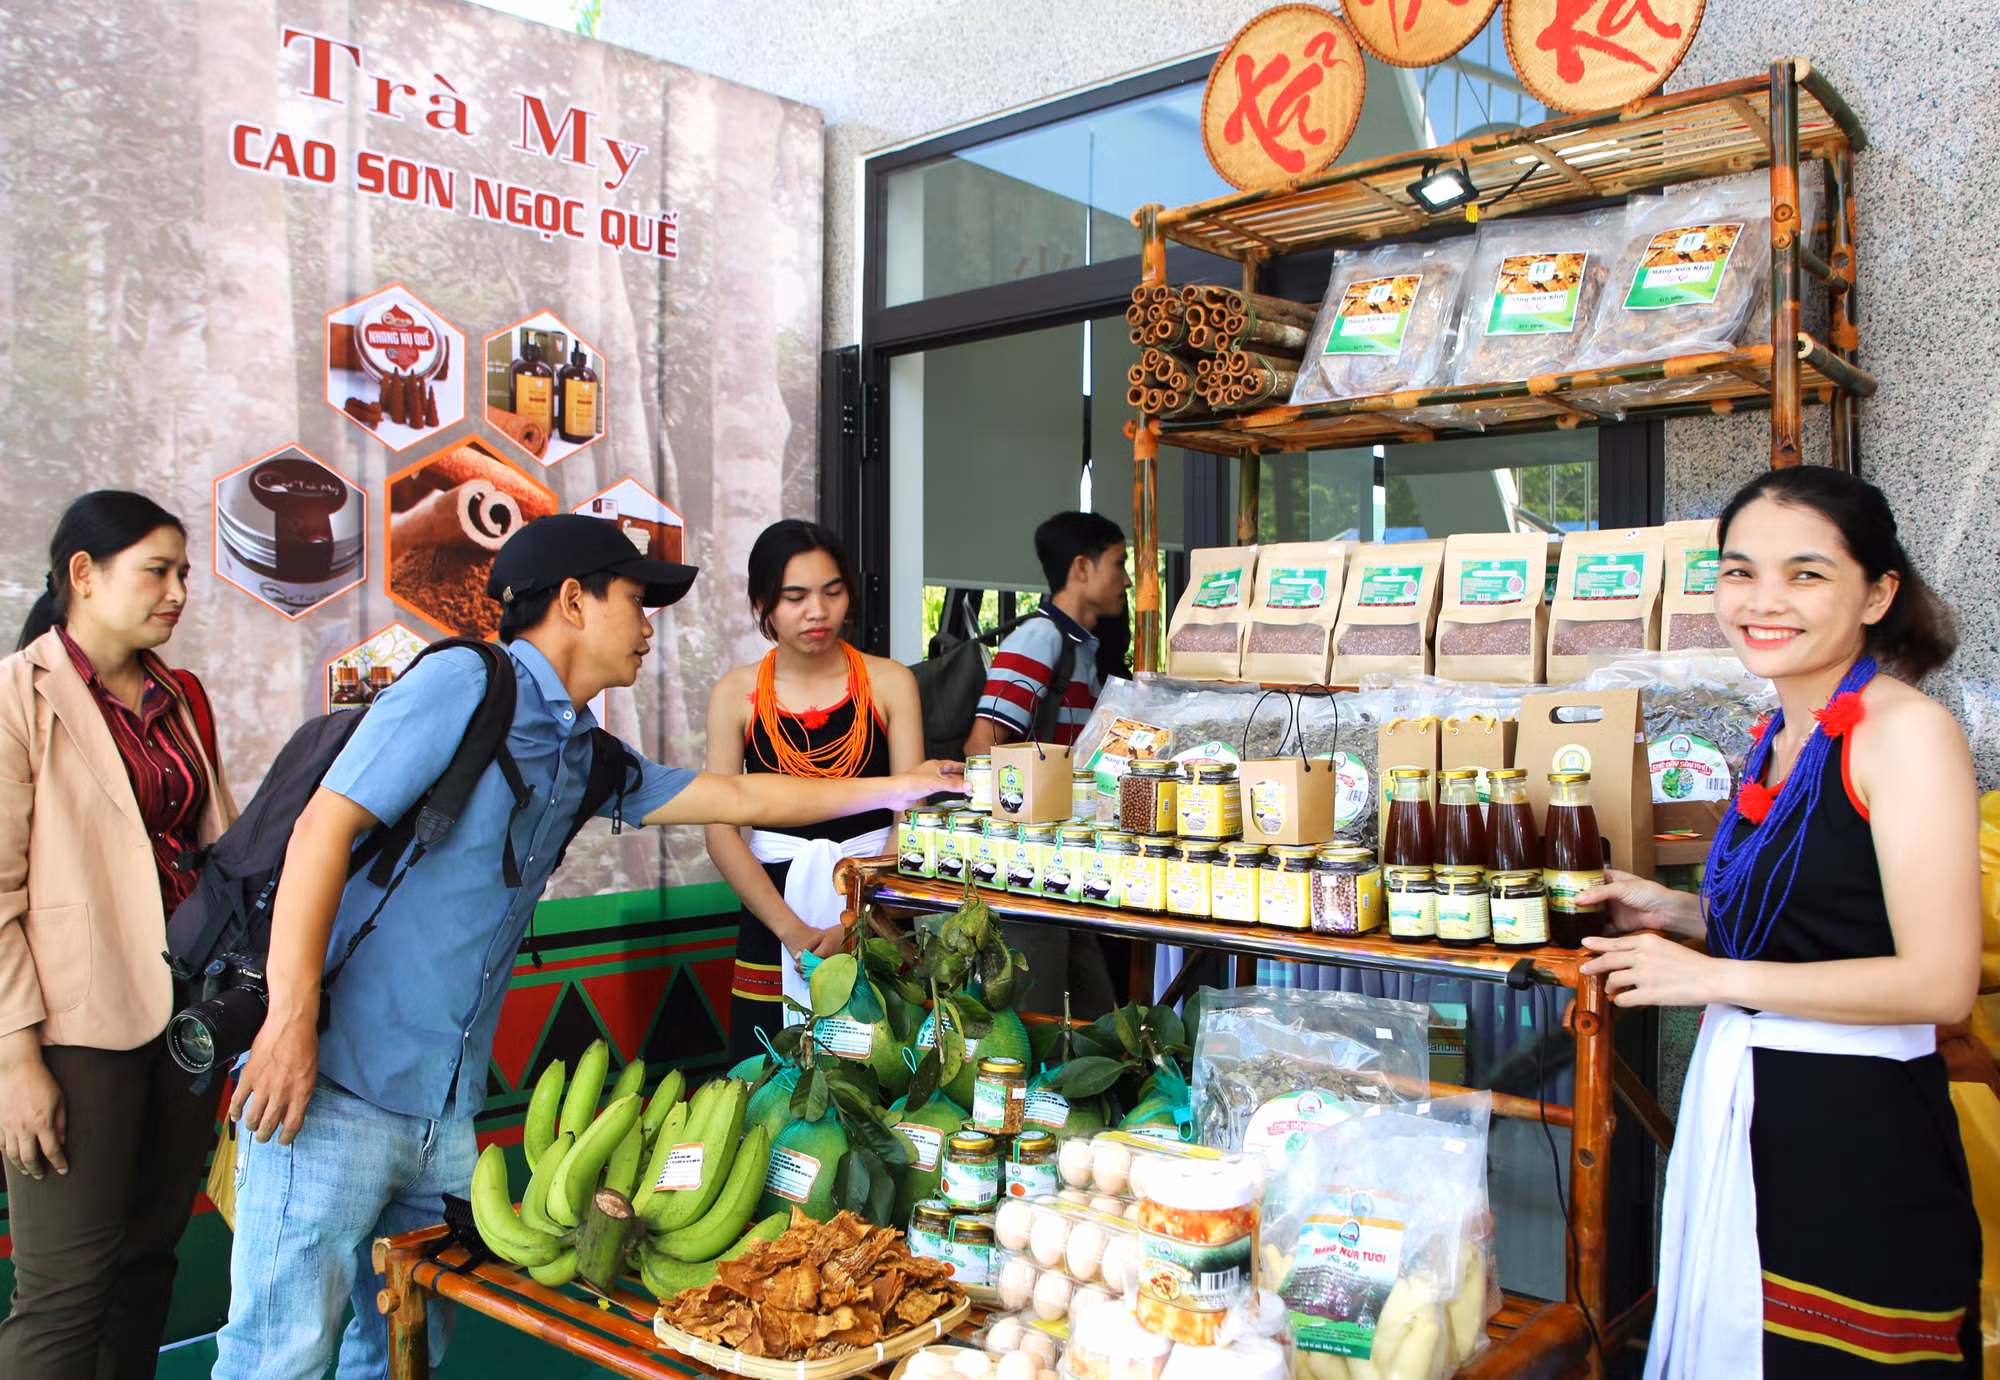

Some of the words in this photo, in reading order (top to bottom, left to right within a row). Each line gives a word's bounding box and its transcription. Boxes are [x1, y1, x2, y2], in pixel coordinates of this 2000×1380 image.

[282, 28, 476, 137] Trà
[511, 90, 647, 191] My
[232, 124, 336, 184] CAO
[357, 151, 455, 210] SƠN
[474, 178, 586, 241] NGỌC
[600, 208, 680, 259] QUẾ
[368, 330, 400, 345] NHANG
[241, 968, 262, 980] Canon
